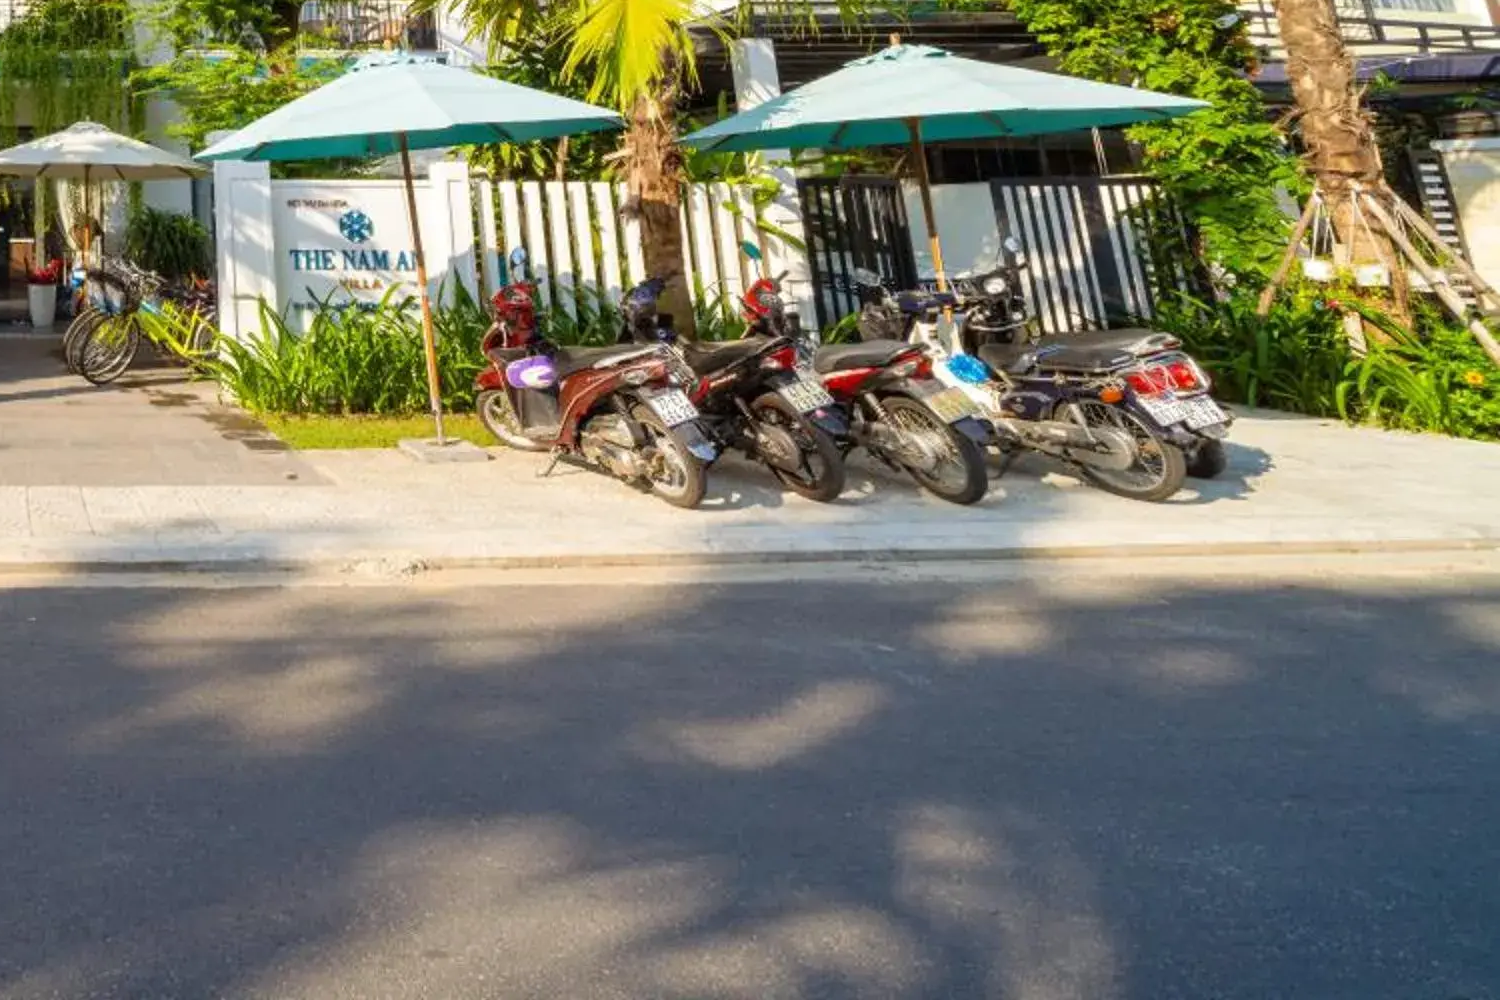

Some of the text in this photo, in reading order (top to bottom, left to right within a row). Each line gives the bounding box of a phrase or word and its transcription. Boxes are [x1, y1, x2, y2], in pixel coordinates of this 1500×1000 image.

[289, 249, 336, 271] THE
[341, 249, 389, 271] NAM
[340, 279, 383, 290] VILLA
